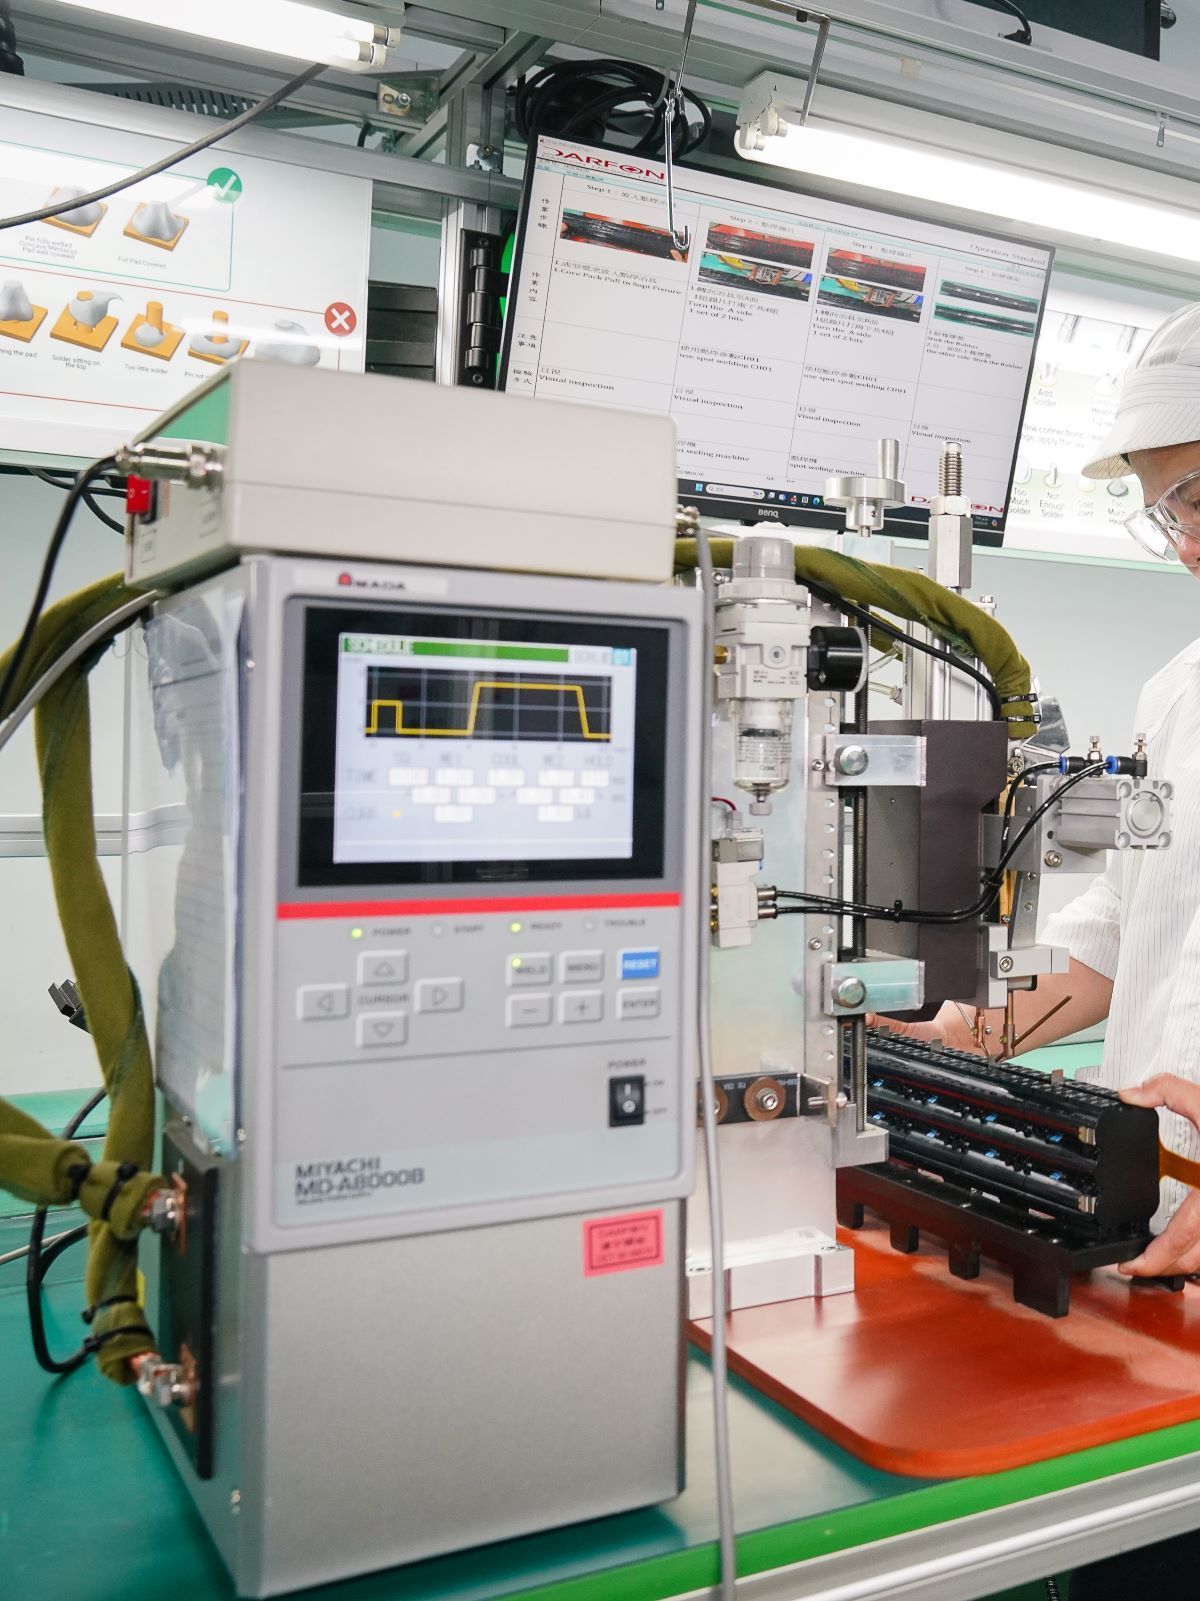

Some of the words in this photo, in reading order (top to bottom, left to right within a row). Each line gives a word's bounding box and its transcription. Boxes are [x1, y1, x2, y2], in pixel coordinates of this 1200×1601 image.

[542, 145, 665, 180] DARFON
[129, 257, 142, 265] Pad
[143, 260, 167, 269] Covered
[12, 349, 24, 357] the
[25, 351, 38, 359] pad
[52, 354, 72, 364] Solder
[77, 363, 87, 371] top
[124, 363, 136, 371] Too
[150, 366, 169, 376] solder
[539, 374, 568, 385] Visual
[569, 378, 615, 391] inspection
[673, 394, 700, 404] Visual
[701, 397, 744, 411] inspection
[797, 413, 826, 423] Visual
[826, 416, 862, 428] inspection
[715, 453, 751, 462] machine
[789, 462, 808, 471] spot
[1013, 487, 1027, 497] Too
[623, 957, 659, 972] RESET
[607, 1057, 648, 1070] POWER
[295, 1156, 382, 1178] MIYACHI
[295, 1167, 425, 1197] MD-A8000B
